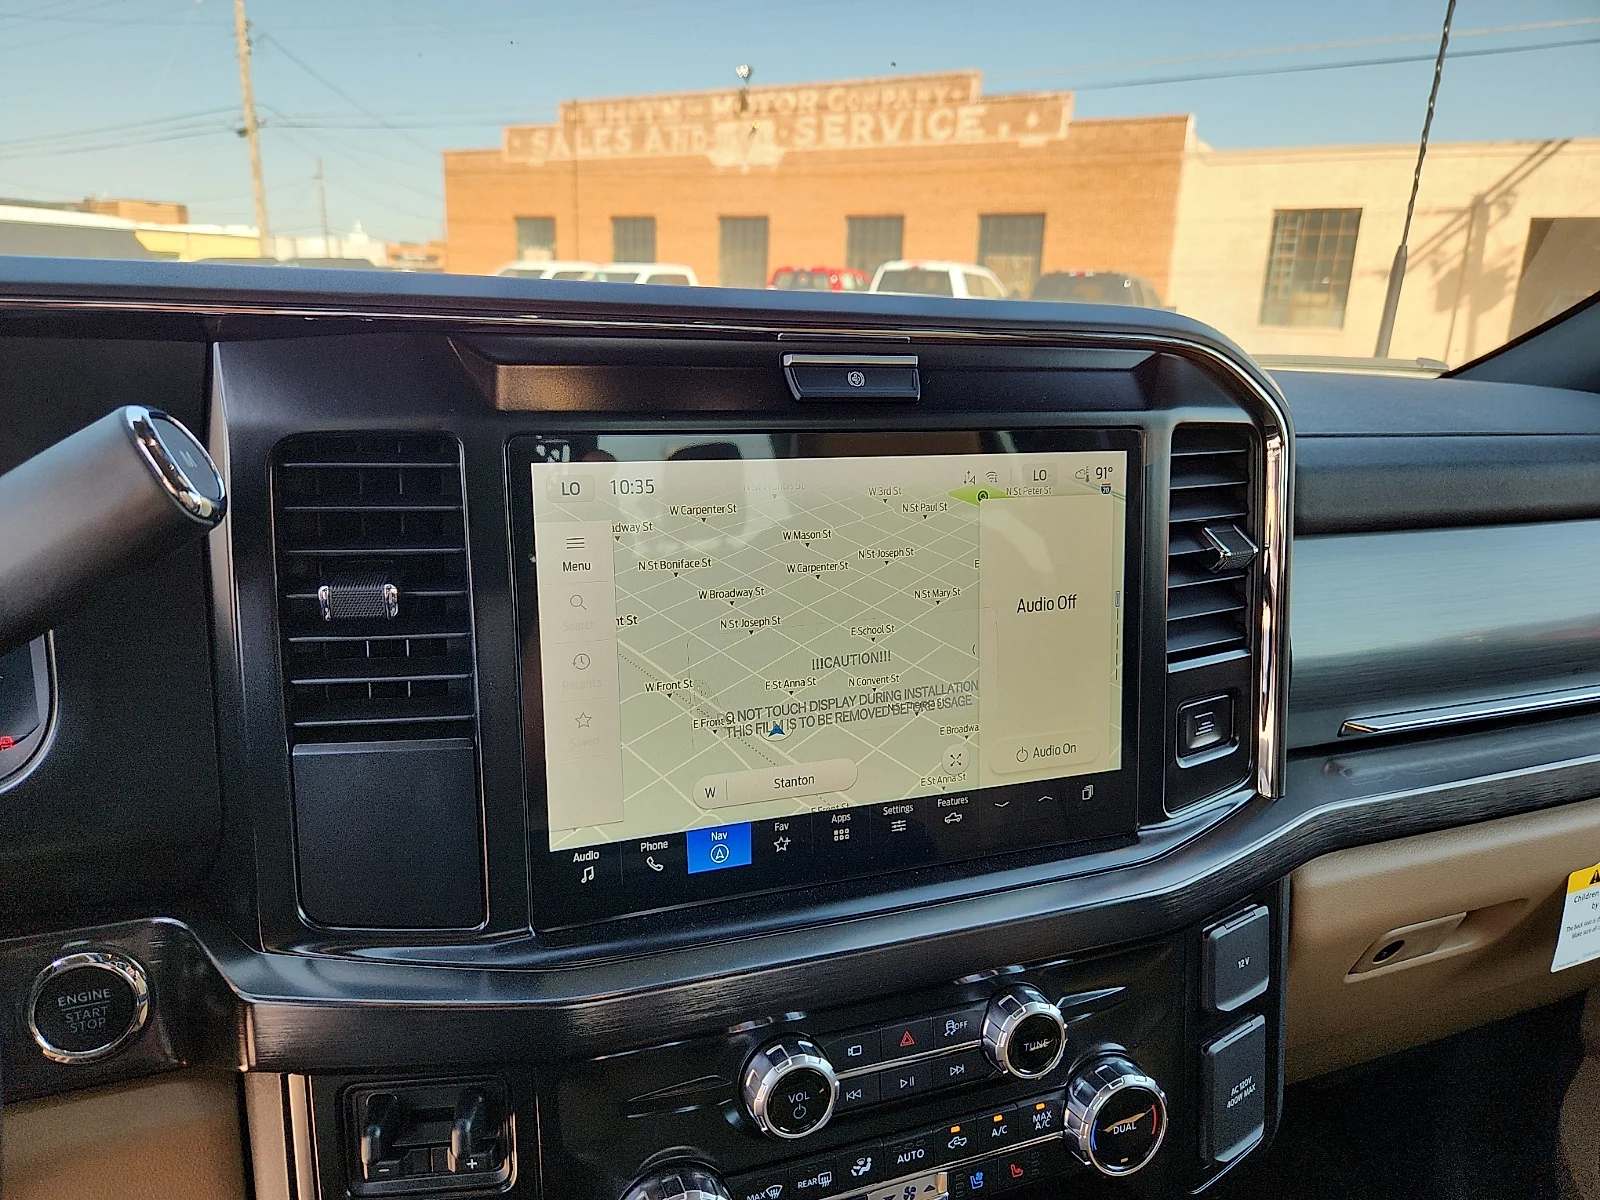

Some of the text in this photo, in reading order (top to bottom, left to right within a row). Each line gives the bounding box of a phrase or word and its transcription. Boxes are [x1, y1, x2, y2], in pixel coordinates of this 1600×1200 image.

[530, 125, 633, 159] SALES
[794, 104, 988, 148] SERVICE
[1034, 469, 1047, 481] LO
[561, 482, 581, 496] LO
[610, 479, 655, 495] 10:35
[869, 486, 902, 496] W 3rd St
[1006, 486, 1052, 495] N St Peter St
[669, 503, 737, 516] W Carpenter St
[902, 502, 948, 512] N St Paul St
[642, 521, 653, 531] St
[782, 529, 832, 541] W Mason St
[858, 547, 914, 559] N St Joseph St
[562, 561, 591, 572] Menu
[638, 558, 712, 570] N St Boniface St
[787, 561, 849, 574] W Carpenter St
[698, 587, 765, 601] W Broadway St
[914, 588, 961, 600] N St Mary St
[1016, 594, 1077, 613] Audio Off
[626, 615, 638, 625] St
[720, 616, 781, 630] N St Joseph St
[851, 624, 895, 635] E School St
[645, 679, 693, 692] W Front St
[766, 677, 816, 690] E St Anna St
[849, 674, 900, 686] N Convent St
[738, 707, 762, 721] NOT
[765, 702, 806, 717] TOUCH
[809, 695, 857, 712] DISPLAY
[859, 690, 901, 706] DURING
[904, 680, 979, 699] INSTALLATION
[726, 724, 753, 738] THIS
[756, 720, 784, 735] FILM
[786, 718, 797, 731] IS
[799, 716, 815, 728] TO
[818, 713, 833, 726] BE
[835, 706, 890, 724] REMOVED
[937, 695, 972, 710] USAGE
[693, 720, 698, 729] E
[701, 718, 725, 728] Front
[940, 727, 945, 735] E
[1033, 743, 1077, 759] Audio On
[774, 774, 815, 788] Stanton
[920, 772, 966, 787] E St Anna St
[705, 787, 716, 798] W
[937, 796, 969, 808] Features
[883, 803, 914, 816] Settings
[831, 813, 851, 824] Apps
[774, 822, 789, 832] Fav
[711, 831, 728, 841] Nav
[640, 840, 669, 852] Phone
[573, 850, 600, 863] Audio
[1574, 890, 1600, 903] Children
[58, 988, 112, 1007] ENGINE
[65, 1006, 108, 1022] START
[70, 1018, 106, 1033] STOP
[955, 1020, 969, 1030] OFF
[1024, 1038, 1049, 1052] TUNE
[789, 1091, 810, 1103] VOL
[1033, 1111, 1052, 1123] MAX
[1035, 1119, 1051, 1131] A/C
[1113, 1121, 1137, 1135] DUAL
[991, 1125, 1008, 1138] A/C
[897, 1149, 925, 1165] AUTO
[798, 1178, 818, 1189] REAR
[747, 1191, 766, 1199] MAX
